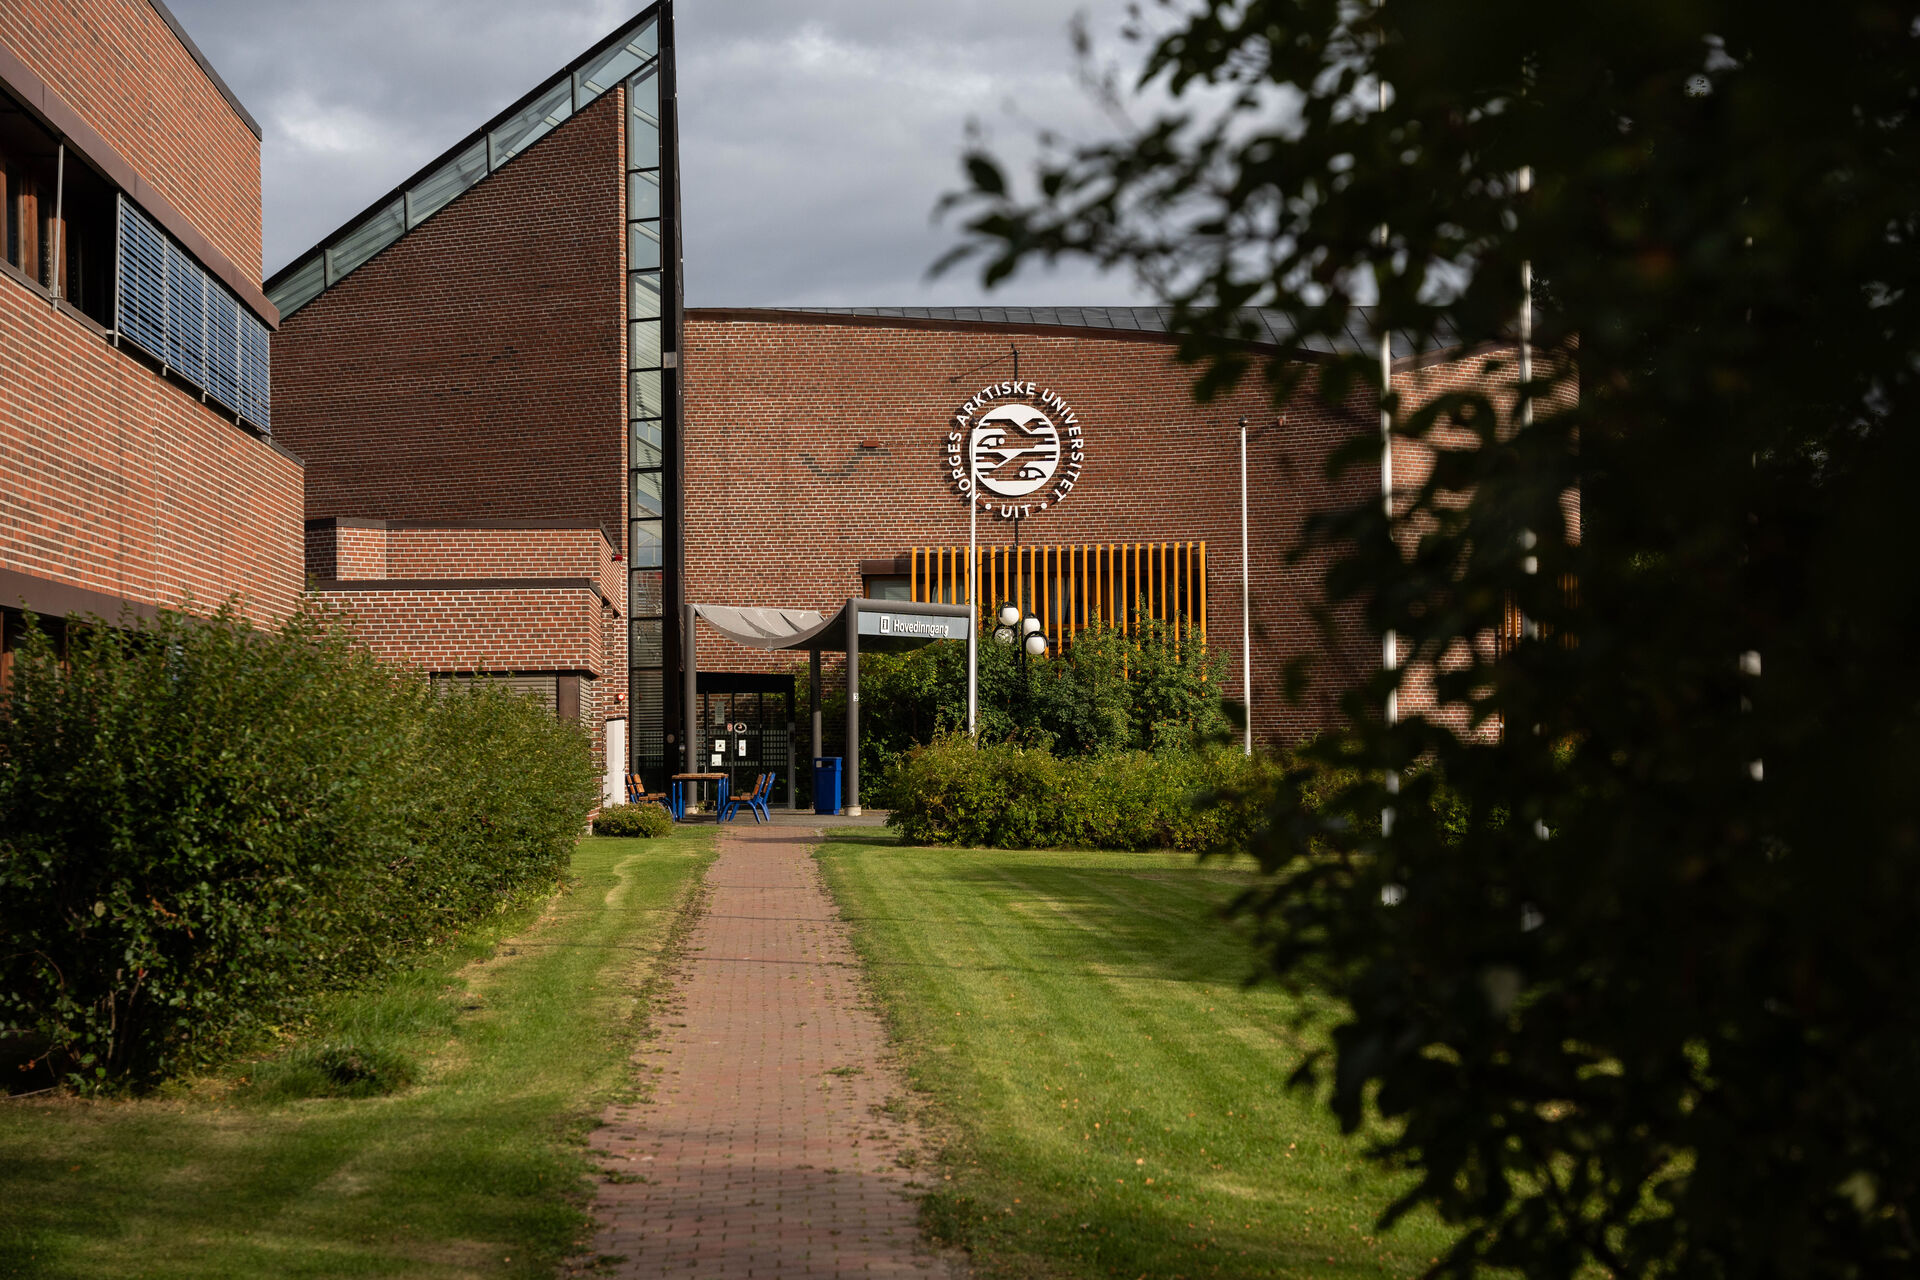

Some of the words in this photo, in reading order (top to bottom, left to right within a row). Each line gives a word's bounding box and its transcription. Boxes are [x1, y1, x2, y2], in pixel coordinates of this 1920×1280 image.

[956, 381, 1036, 427] ARKTISKE
[1041, 389, 1085, 502] UNIVERSITET
[1001, 504, 1031, 518] UIT
[893, 619, 949, 637] Hovedinngang
